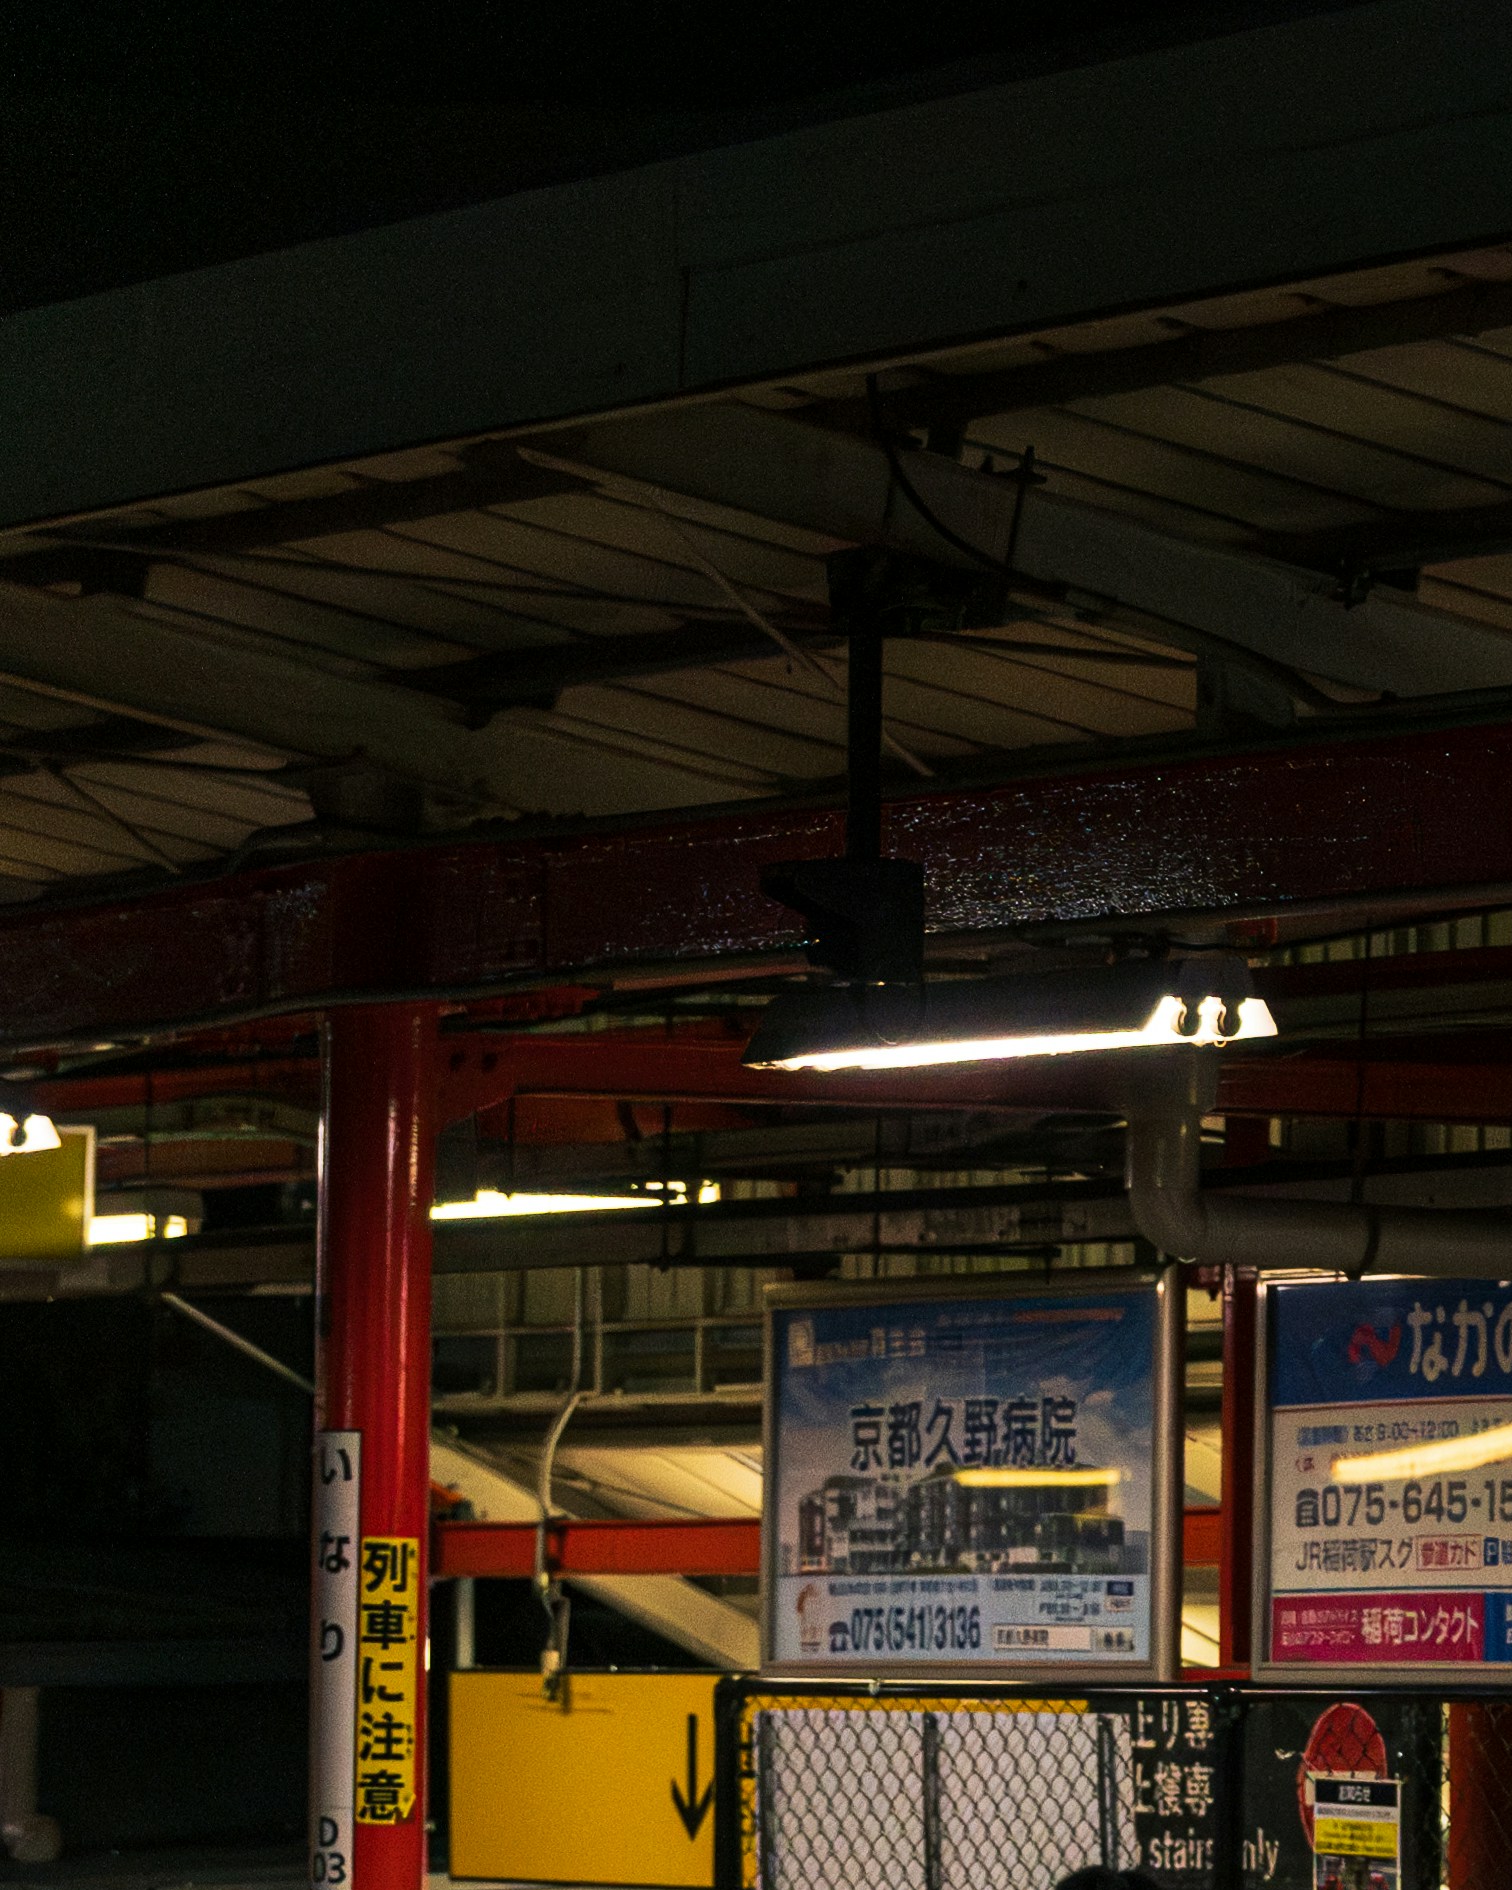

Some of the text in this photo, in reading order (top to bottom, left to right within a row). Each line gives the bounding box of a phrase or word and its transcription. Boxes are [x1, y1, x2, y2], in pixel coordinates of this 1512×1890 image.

[850, 1397, 1076, 1471] 京都久野病院
[319, 1449, 353, 1661] いなり
[851, 1605, 980, 1651] 075(541)3136
[1361, 1607, 1479, 1647] 稲荷コンタクト
[361, 1541, 409, 1822] 列車に注意
[319, 1816, 338, 1847] D
[1242, 1827, 1280, 1882] nly
[314, 1852, 345, 1883] 03
